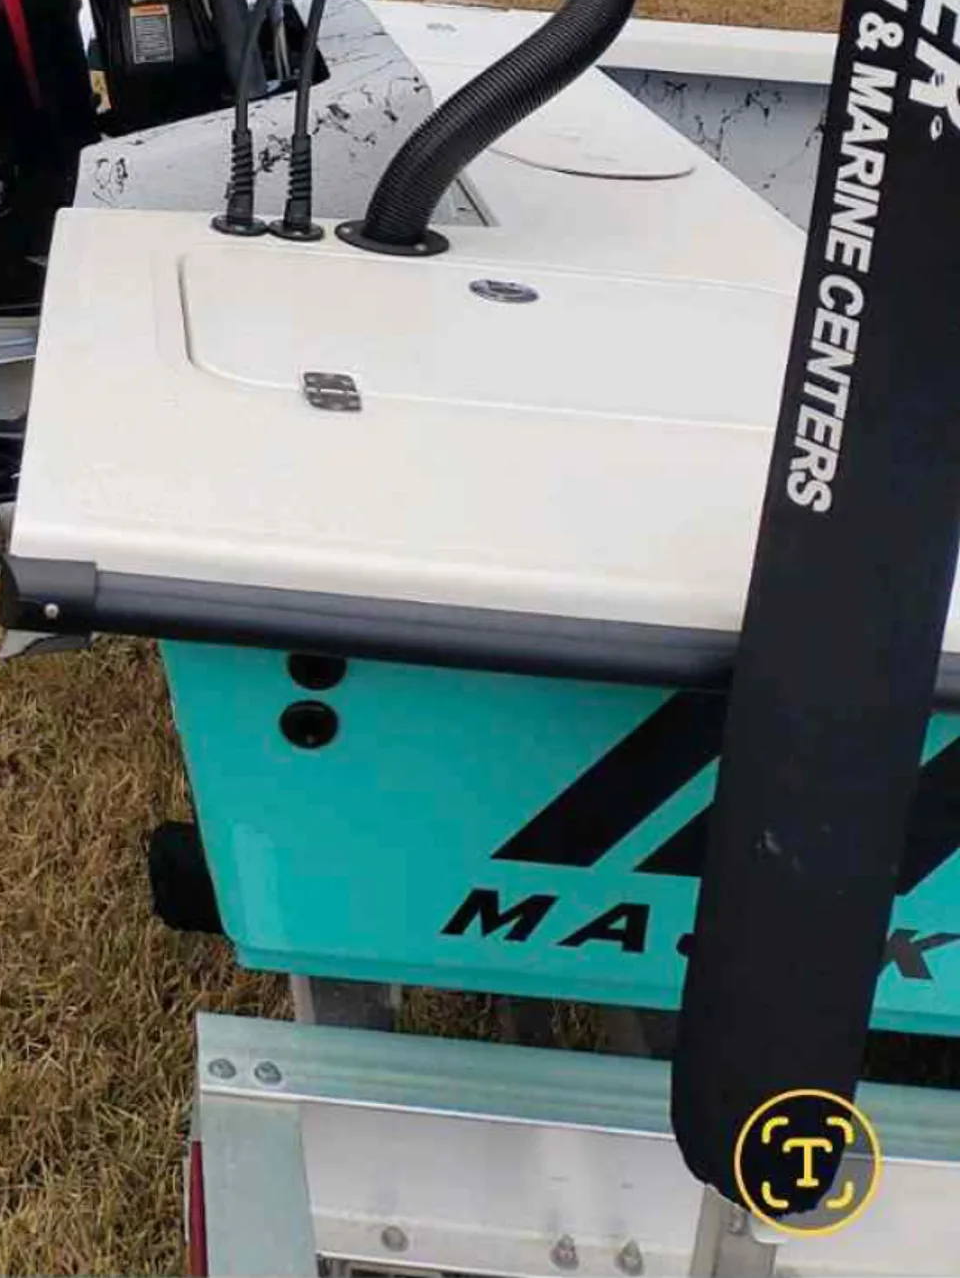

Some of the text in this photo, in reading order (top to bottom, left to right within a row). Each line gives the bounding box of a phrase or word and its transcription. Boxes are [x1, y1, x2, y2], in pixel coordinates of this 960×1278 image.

[855, 12, 904, 52] &
[824, 62, 897, 273] MARINE
[787, 274, 864, 512] CENTERS
